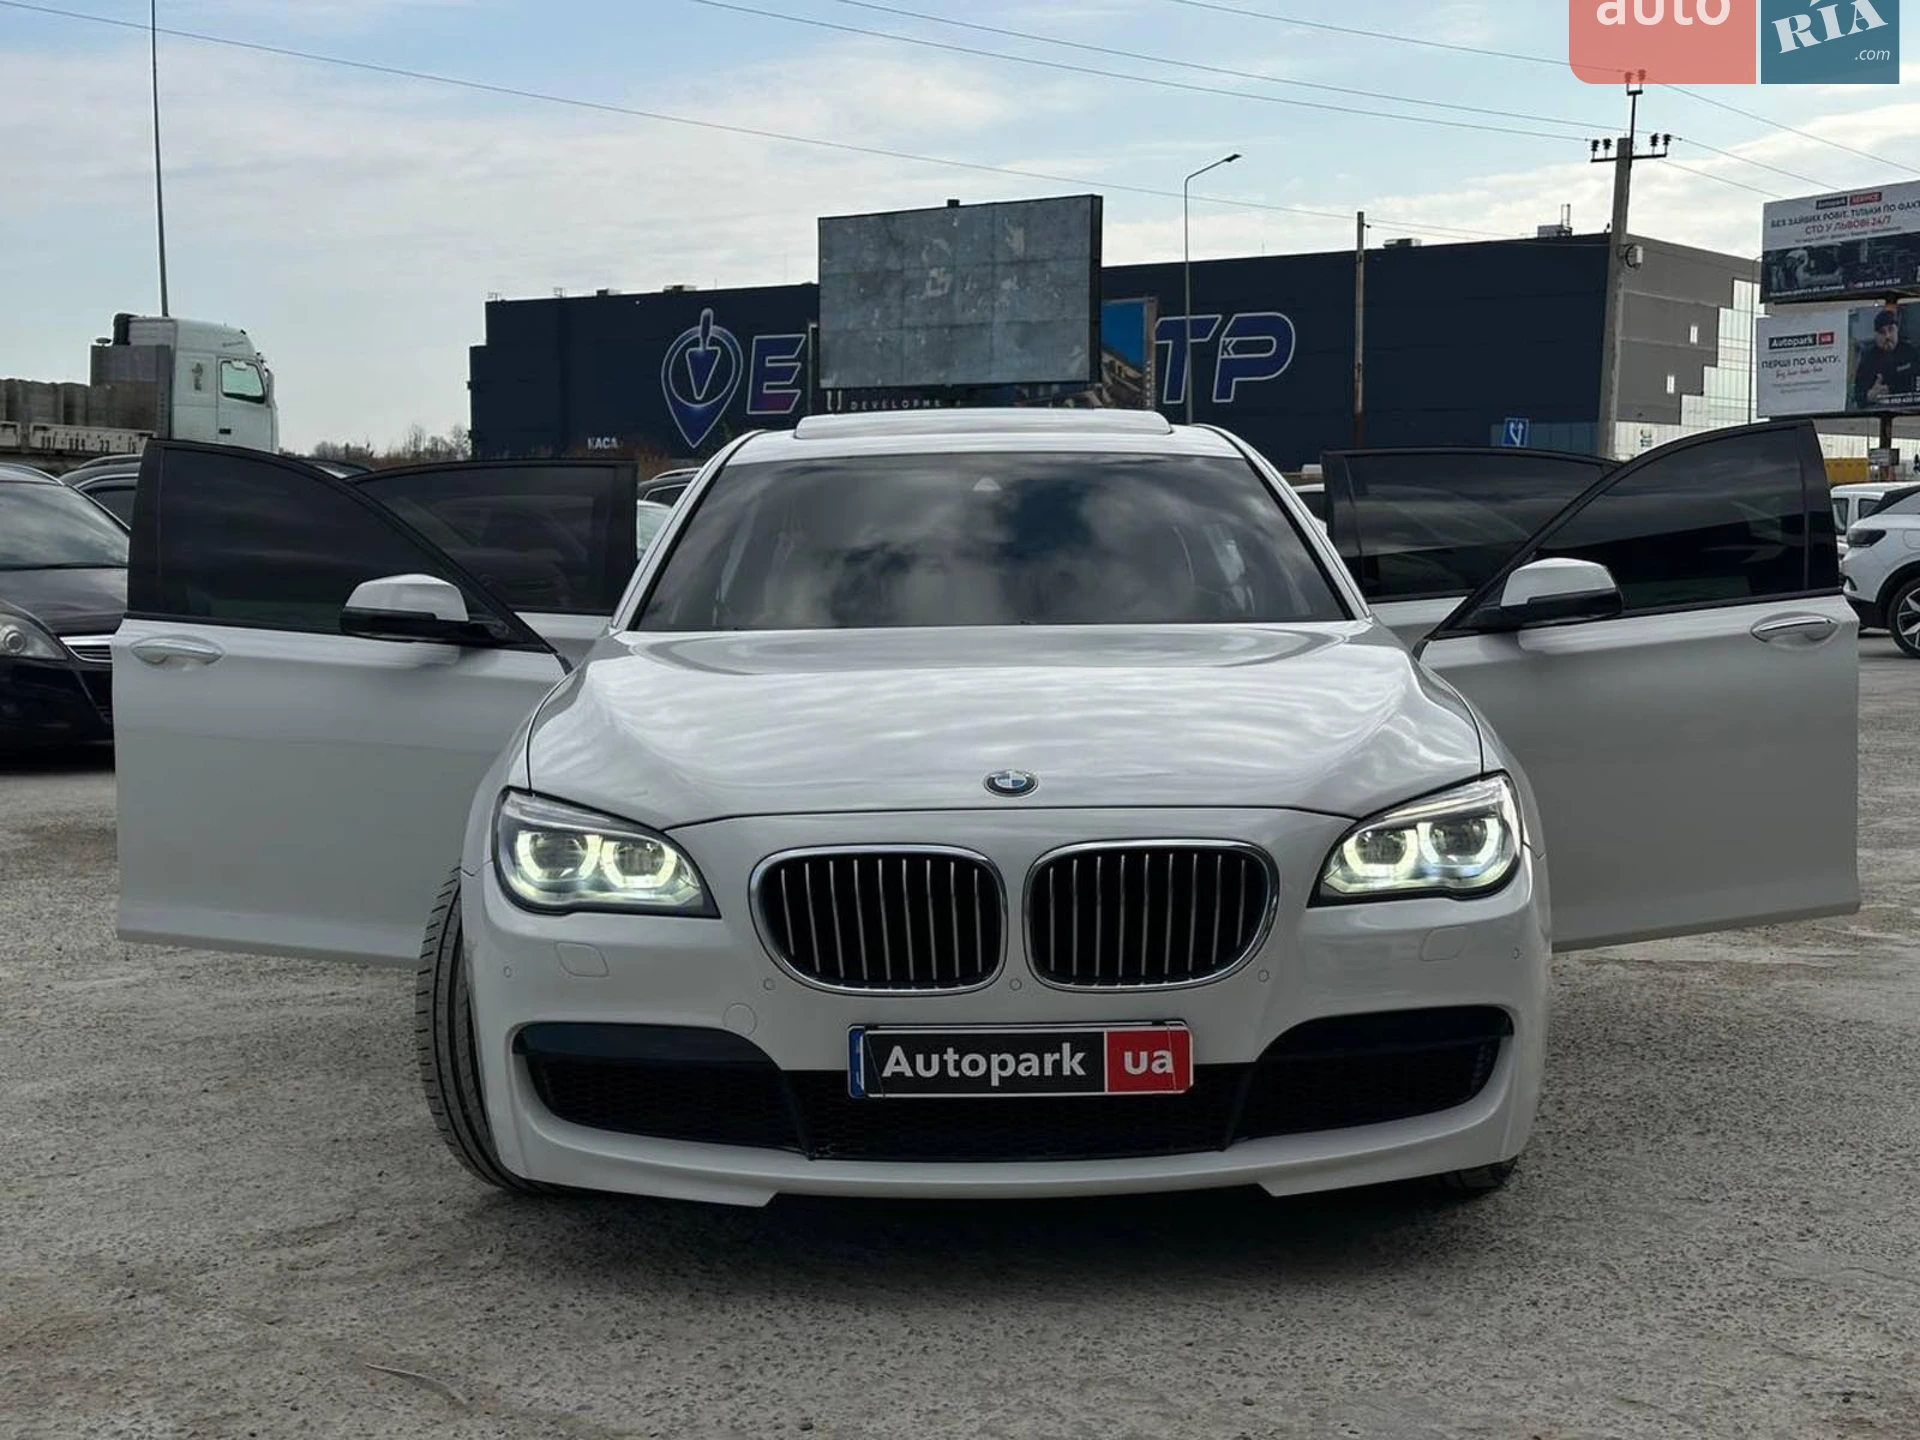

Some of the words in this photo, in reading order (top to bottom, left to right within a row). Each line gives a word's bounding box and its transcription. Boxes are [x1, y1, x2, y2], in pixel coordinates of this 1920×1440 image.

[1882, 203, 1897, 213] ПО
[1804, 224, 1825, 235] СТО
[1771, 333, 1815, 348] Autopark
[1761, 359, 1791, 369] ПЕРШІ
[1793, 357, 1807, 367] ПО
[850, 398, 961, 411] DEVELOPME
[881, 1042, 1087, 1087] Autopark
[1123, 1049, 1175, 1075] ua
